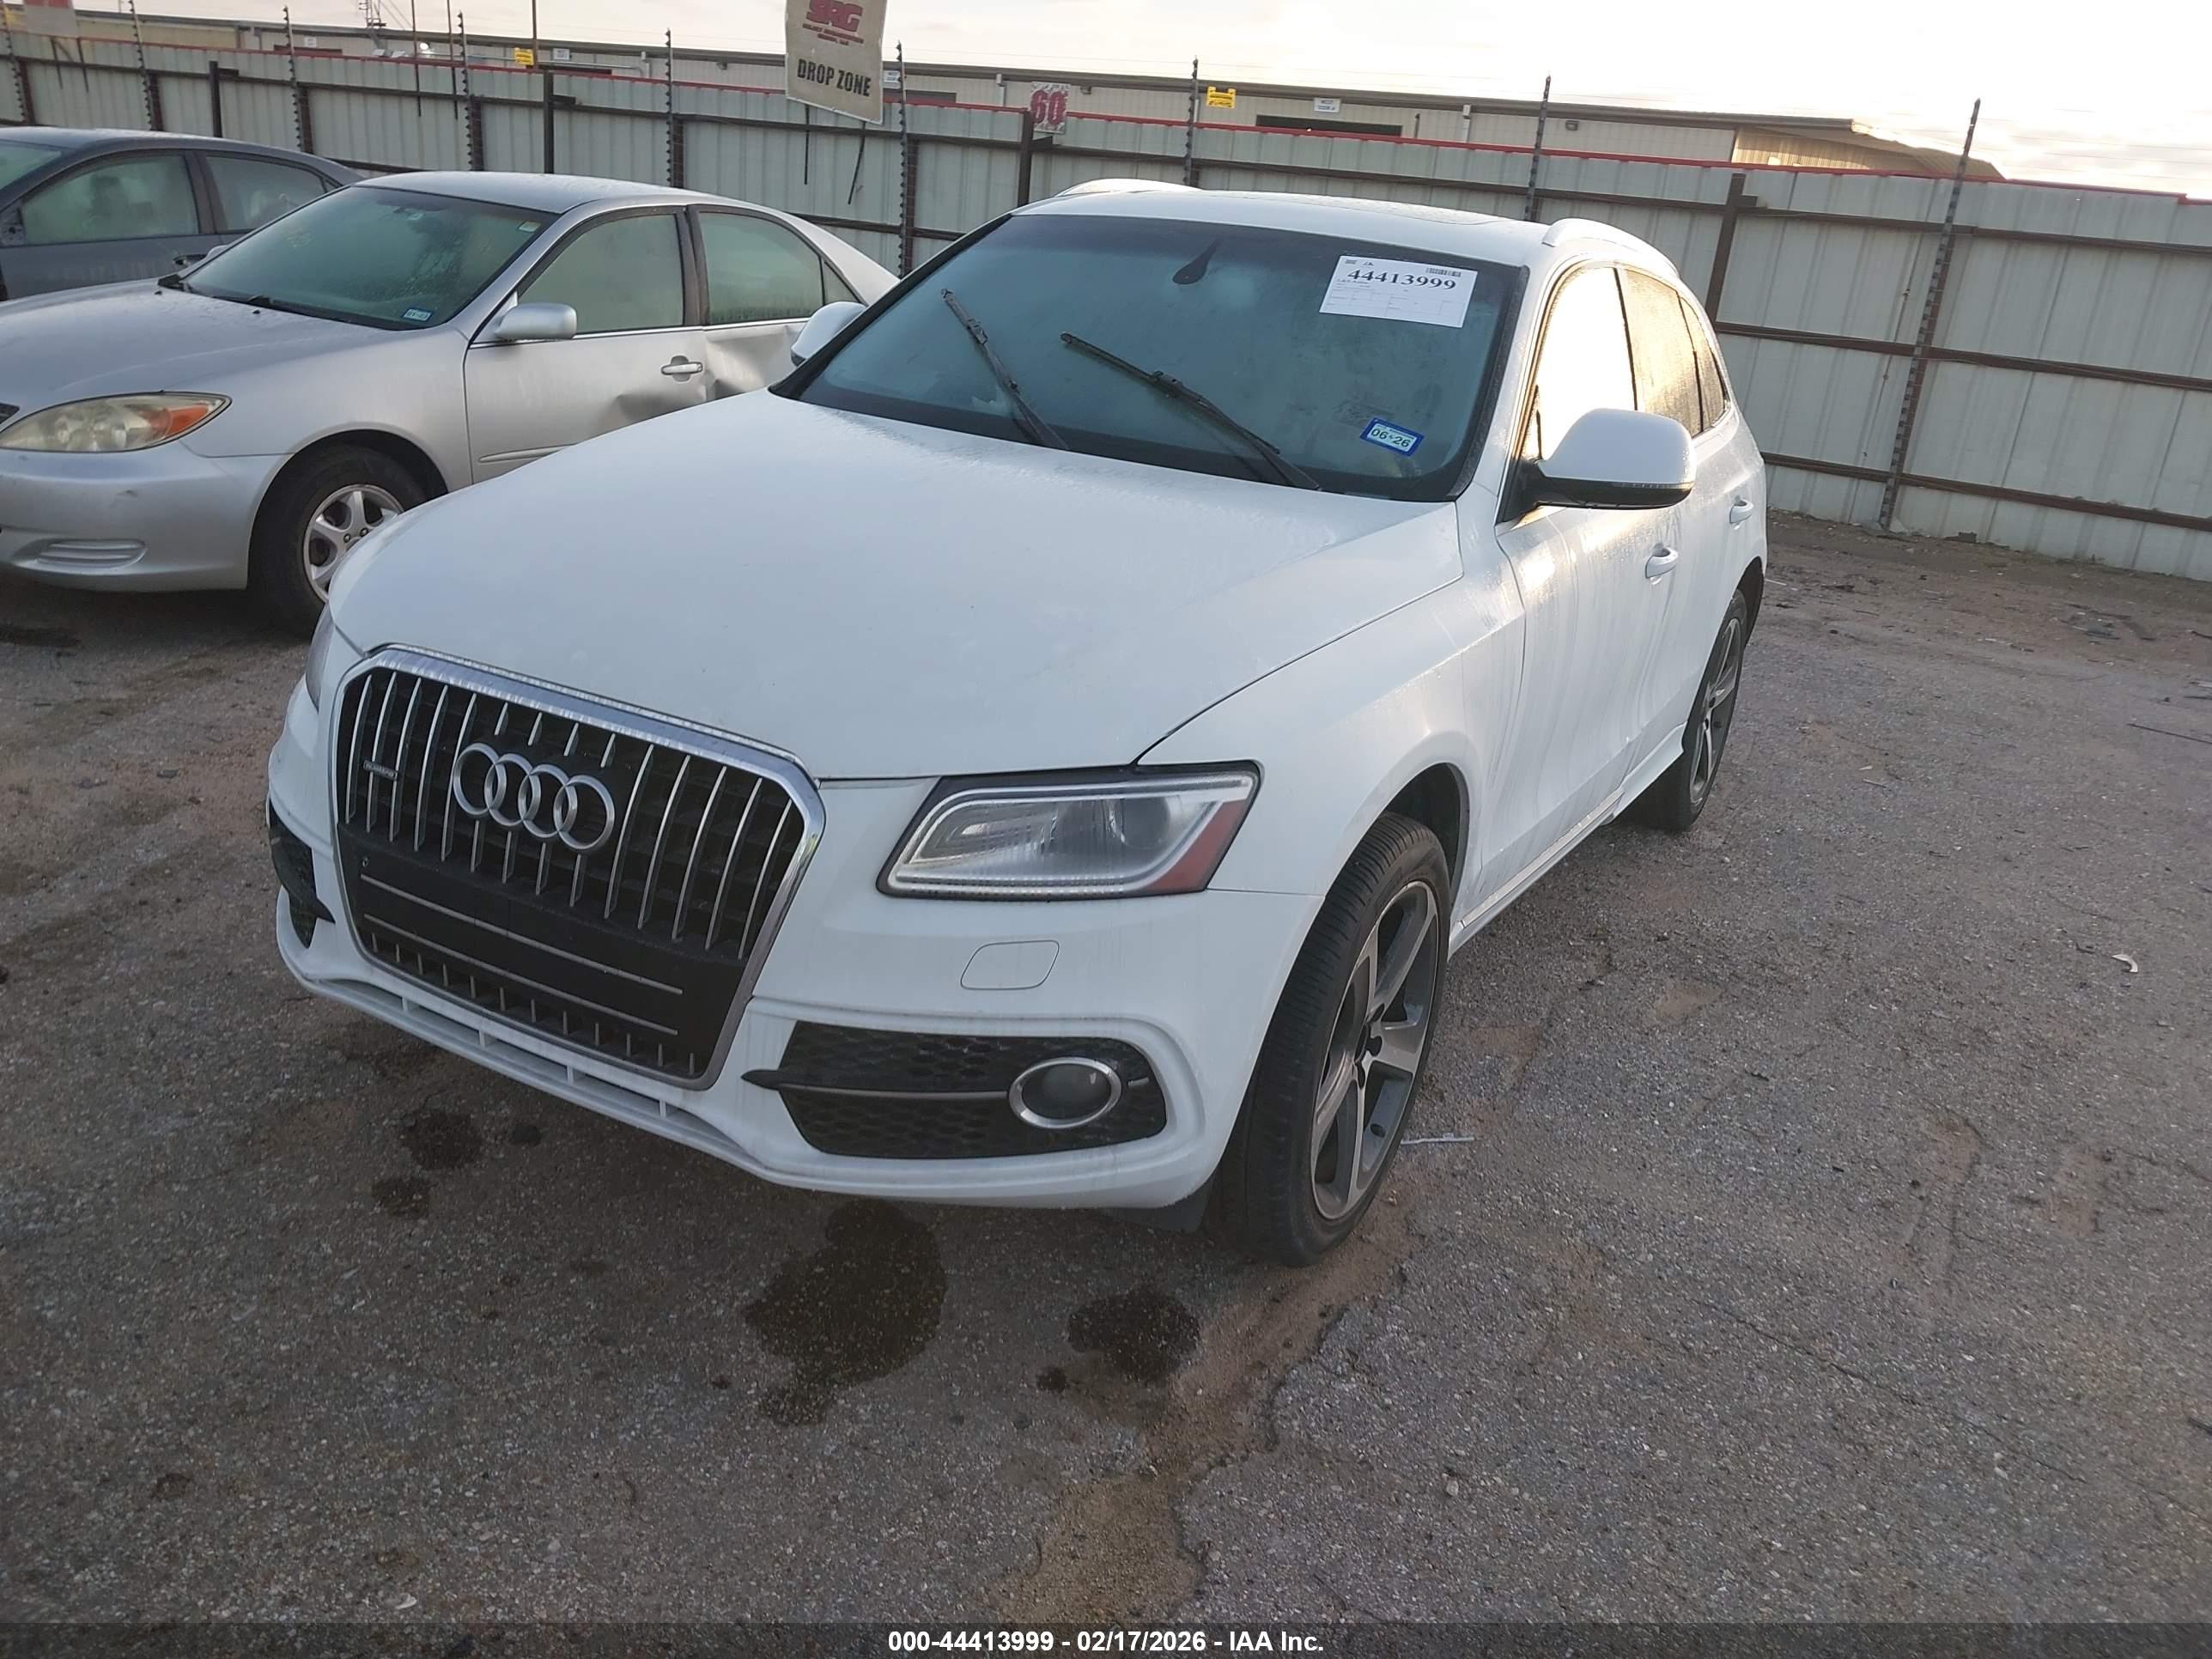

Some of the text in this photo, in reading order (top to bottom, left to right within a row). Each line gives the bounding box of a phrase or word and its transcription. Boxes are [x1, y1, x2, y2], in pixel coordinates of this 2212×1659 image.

[797, 58, 872, 96] DROP ZONE
[1030, 89, 1065, 125] 60
[1347, 269, 1456, 290] 44413999
